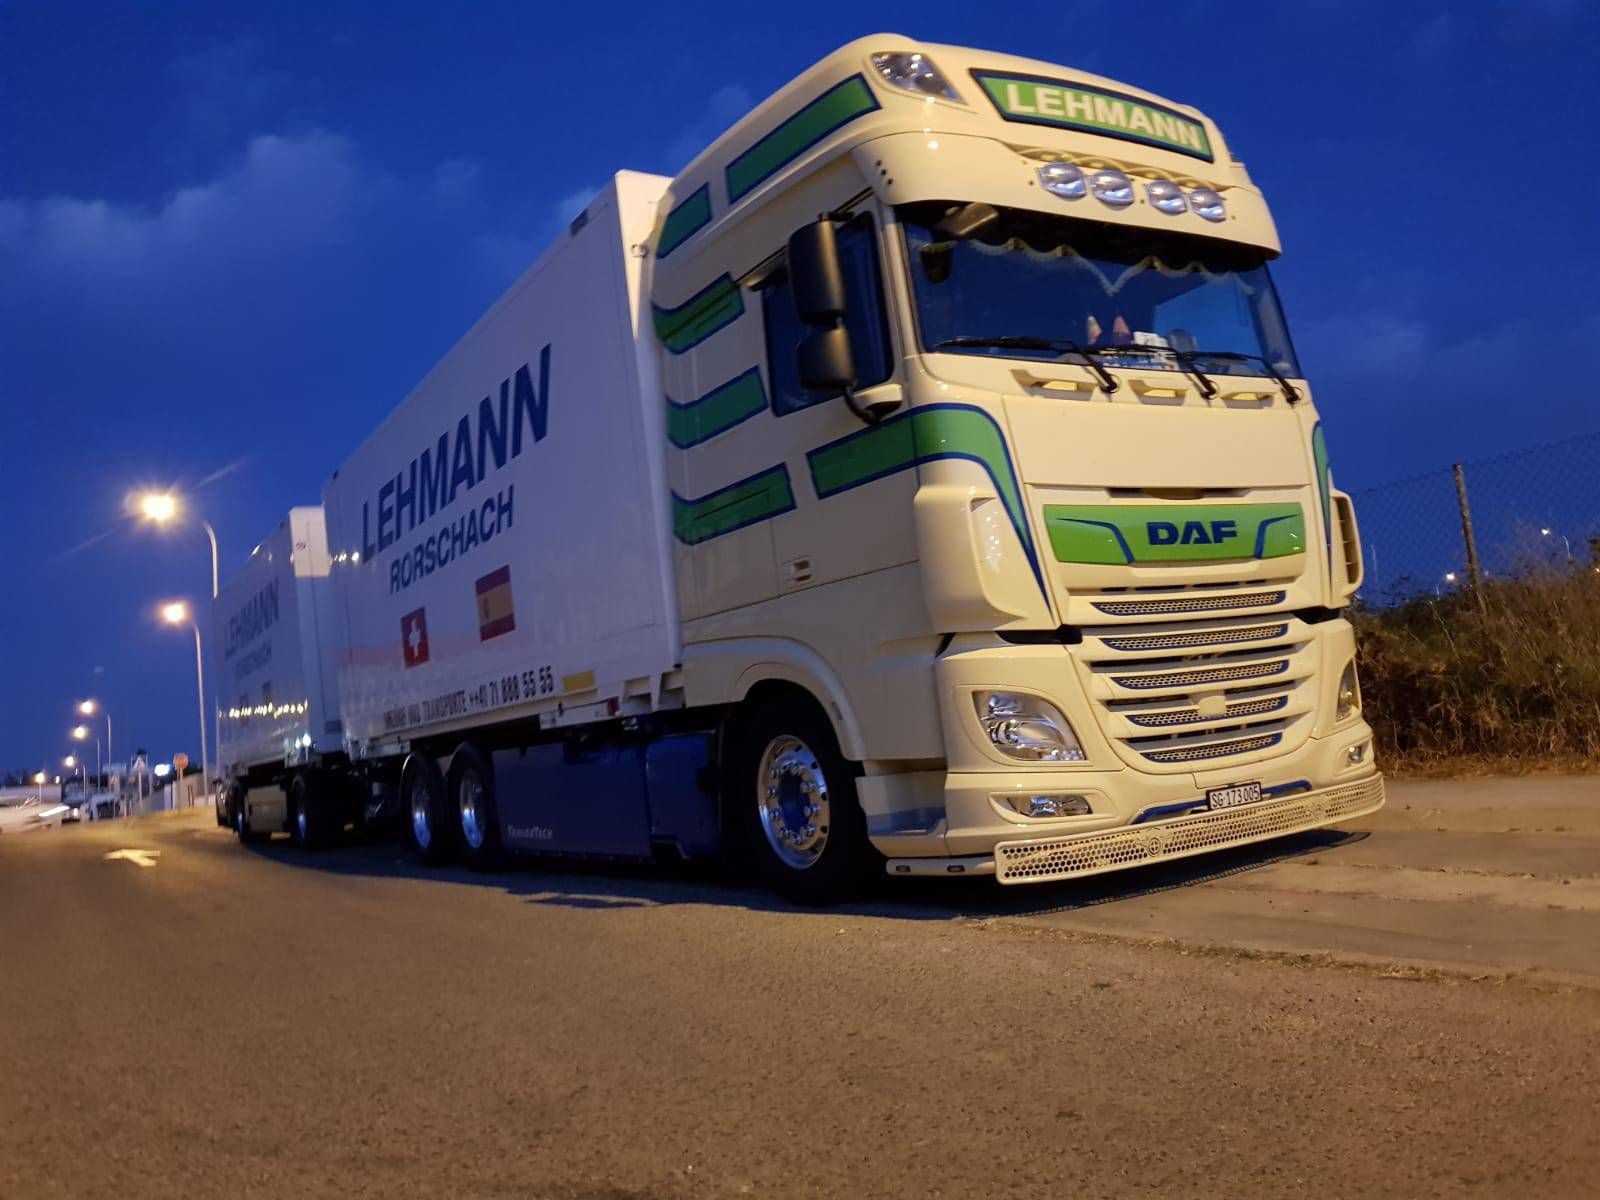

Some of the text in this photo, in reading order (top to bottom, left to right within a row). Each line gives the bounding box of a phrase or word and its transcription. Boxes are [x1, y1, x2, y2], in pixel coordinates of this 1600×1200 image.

[1006, 83, 1204, 150] LEHMANN
[362, 342, 551, 566] LEHMANN
[389, 483, 515, 595] RORSCHACH
[1146, 519, 1238, 546] DAF
[522, 670, 537, 699] 55
[539, 665, 554, 694] 55
